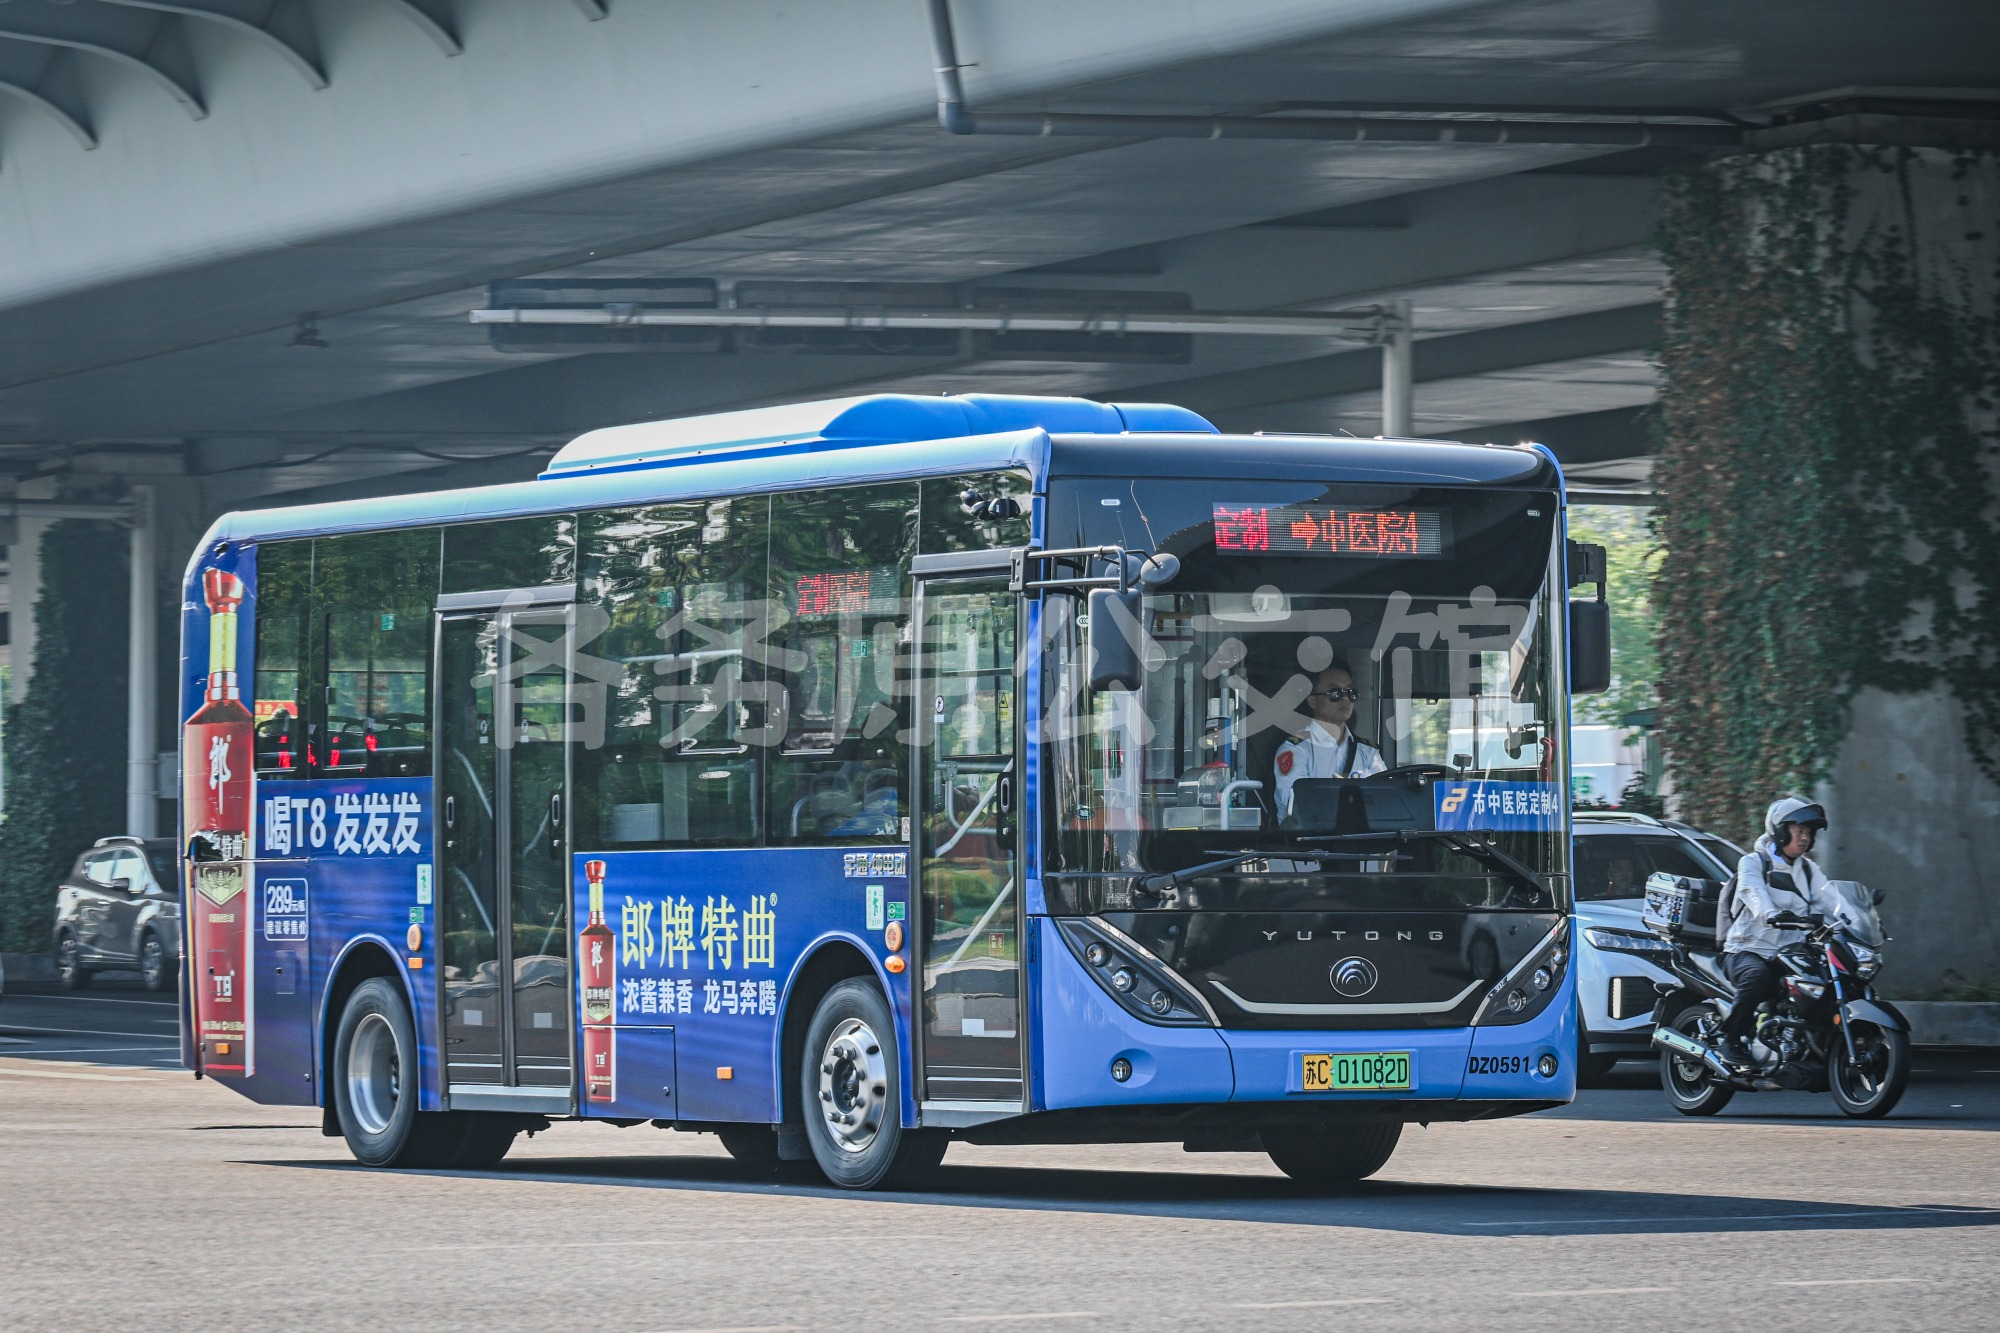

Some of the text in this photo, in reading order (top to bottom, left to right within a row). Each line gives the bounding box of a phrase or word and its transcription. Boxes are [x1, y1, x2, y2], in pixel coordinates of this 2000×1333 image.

[1472, 789, 1559, 816] 市中医院定制4
[1262, 929, 1444, 942] YUTONG
[622, 977, 777, 1015] 浓酱兼香 龙马奔腾
[1305, 1057, 1408, 1085] 苏C 01082D
[1468, 1056, 1530, 1075] DZ0591
